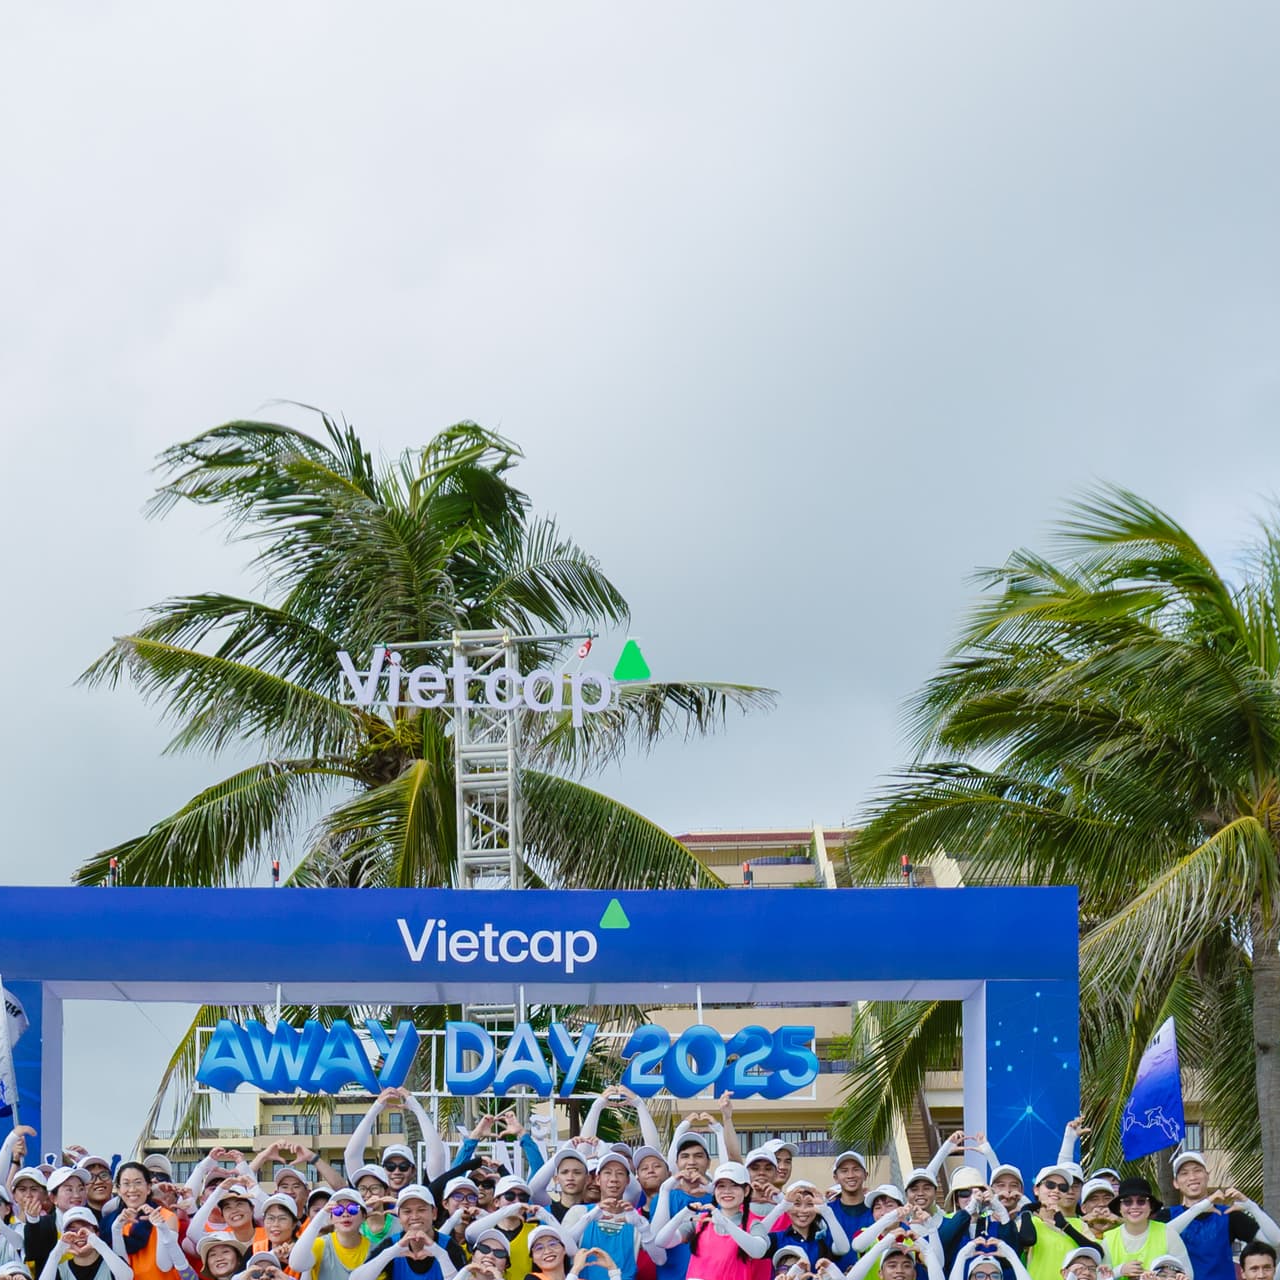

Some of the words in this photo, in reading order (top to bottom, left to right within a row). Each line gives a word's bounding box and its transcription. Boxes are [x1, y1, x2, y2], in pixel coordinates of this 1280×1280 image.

[336, 646, 612, 727] Vietcap
[396, 918, 598, 974] Vietcap
[195, 1018, 420, 1095] AWAY
[444, 1022, 598, 1097] DAY
[620, 1024, 820, 1100] 2025
